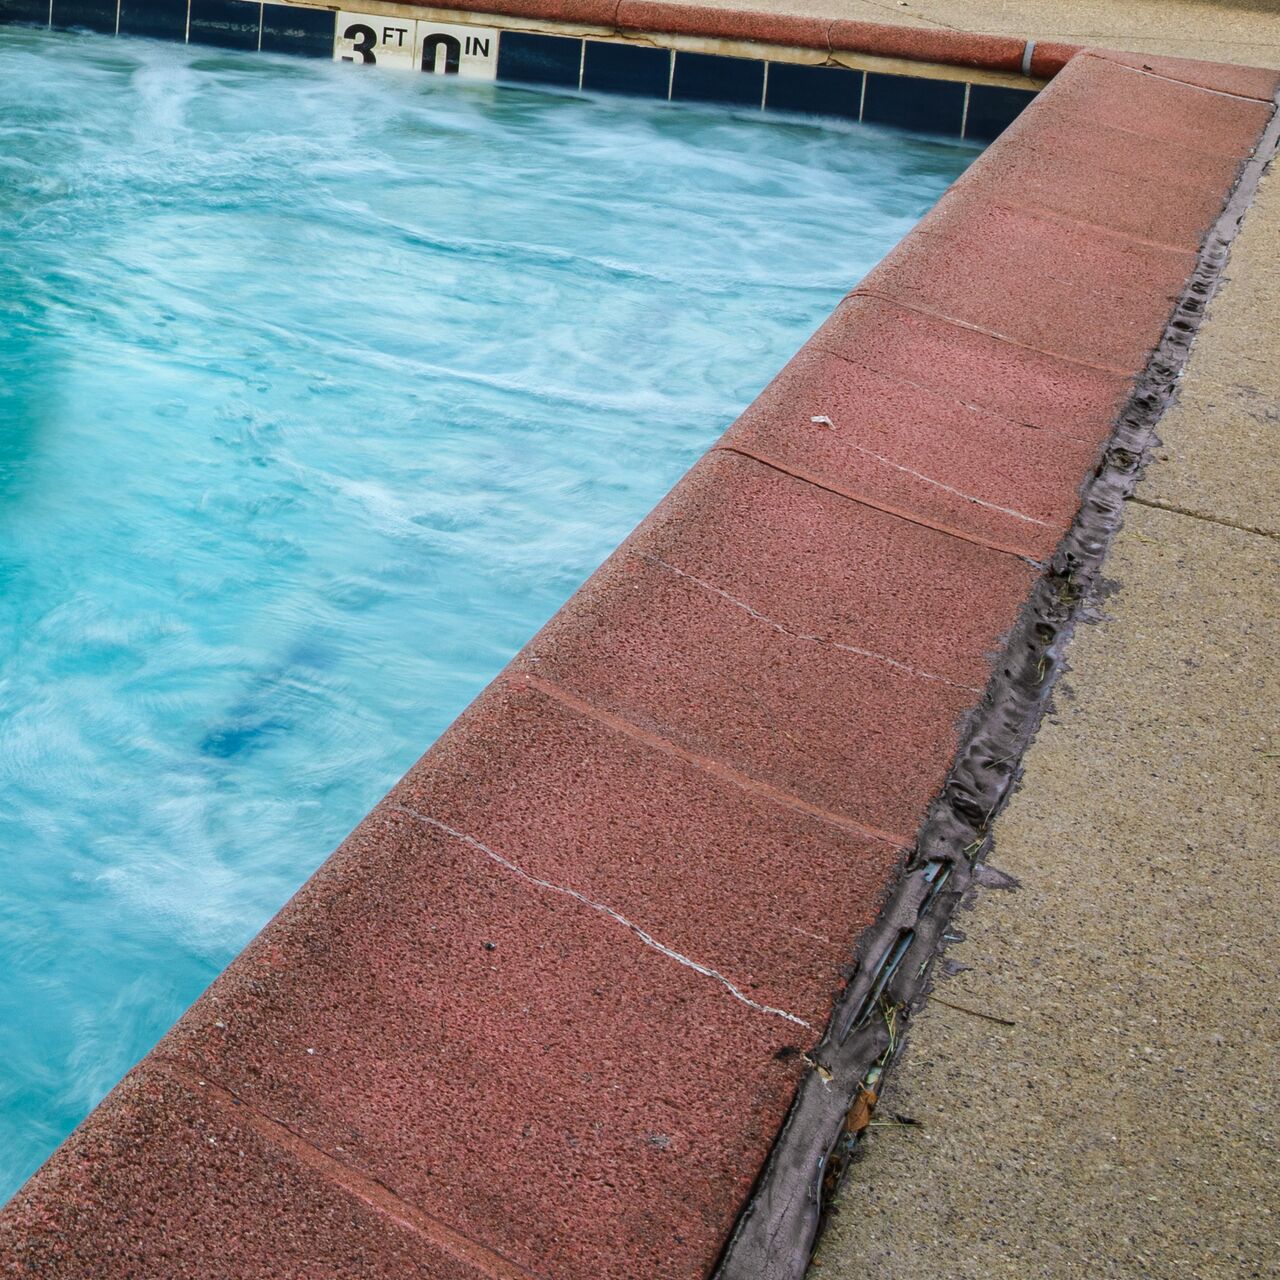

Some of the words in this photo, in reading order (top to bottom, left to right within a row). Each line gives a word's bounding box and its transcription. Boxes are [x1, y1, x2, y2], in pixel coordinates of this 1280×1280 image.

[342, 23, 377, 65] 3
[382, 26, 408, 47] FT
[421, 32, 461, 74] 0
[465, 36, 490, 58] IN
